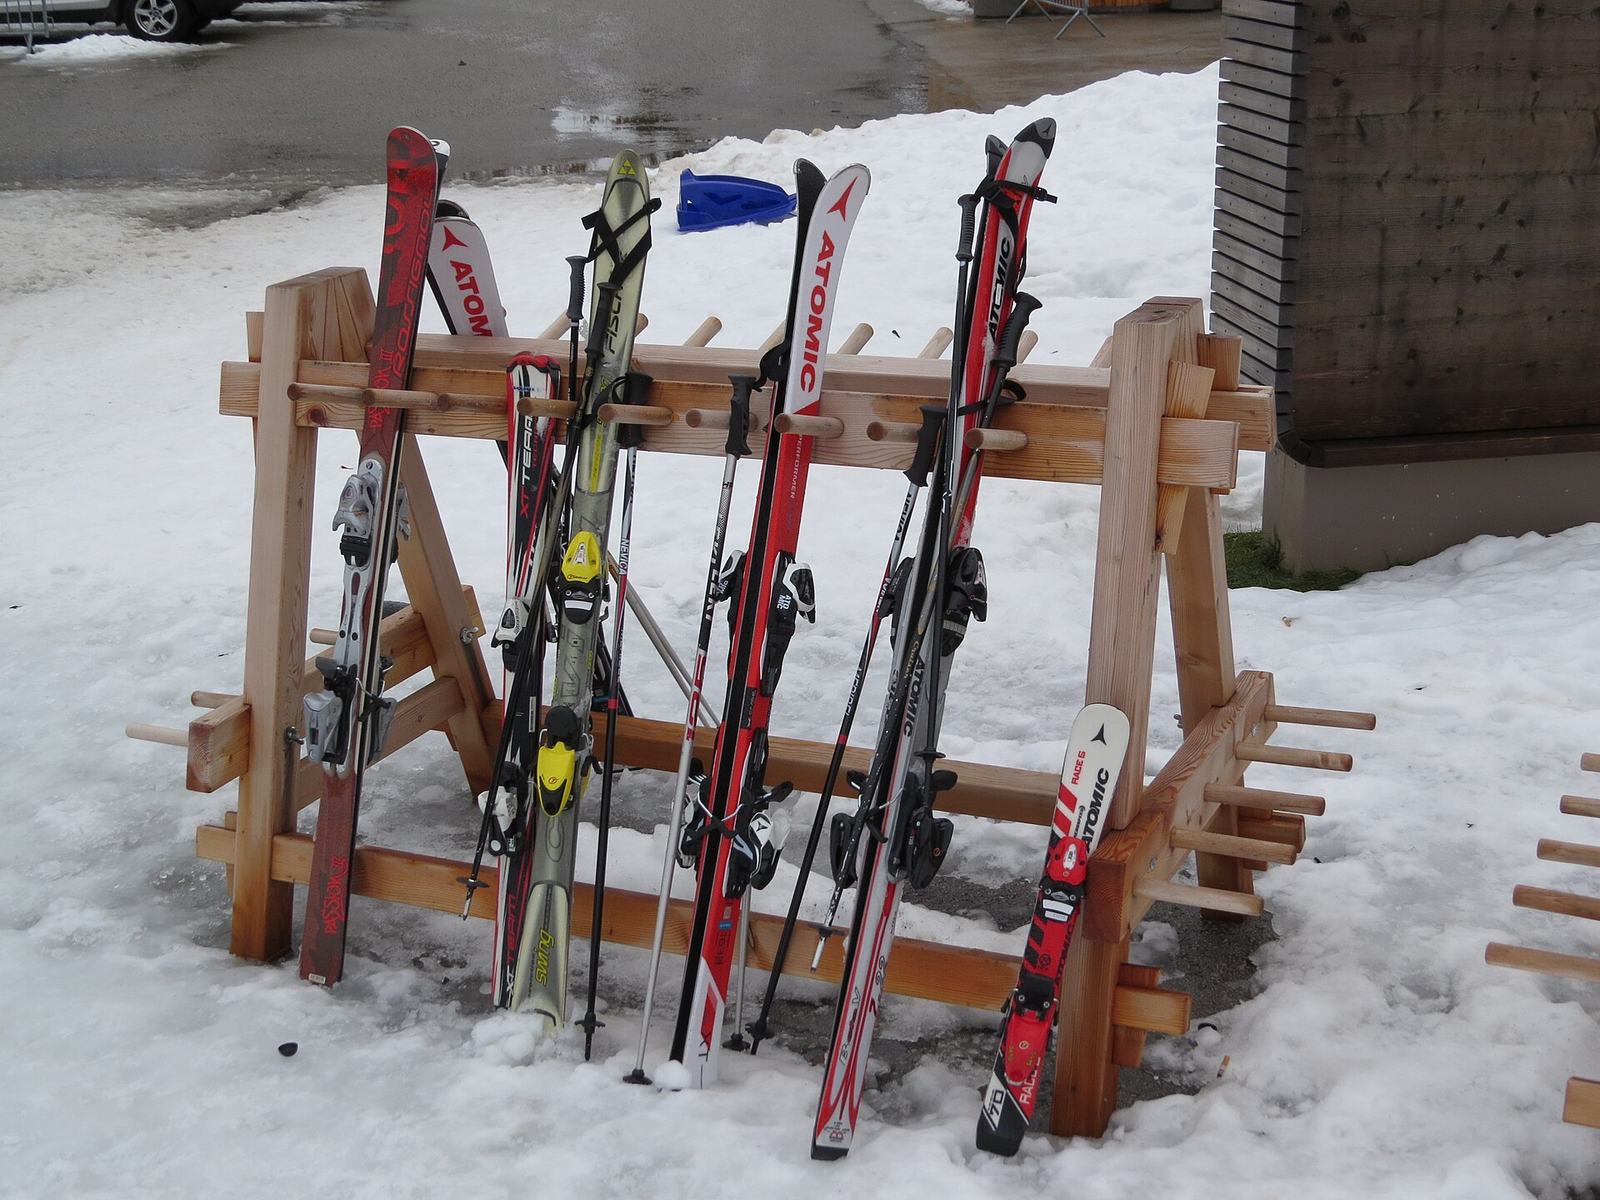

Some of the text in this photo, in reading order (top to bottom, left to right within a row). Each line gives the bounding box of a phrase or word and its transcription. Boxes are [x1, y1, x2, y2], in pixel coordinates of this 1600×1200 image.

[392, 189, 435, 378] ROSSIGNOL
[449, 260, 493, 337] ATOM
[800, 230, 836, 393] ATOMIC
[519, 488, 530, 519] XT
[618, 538, 631, 576] NEVICA
[903, 652, 926, 738] ATOMIC
[1072, 758, 1084, 785] RACE
[1081, 767, 1110, 854] ATOMIC
[535, 928, 556, 986] swing
[989, 1088, 1005, 1118] 70
